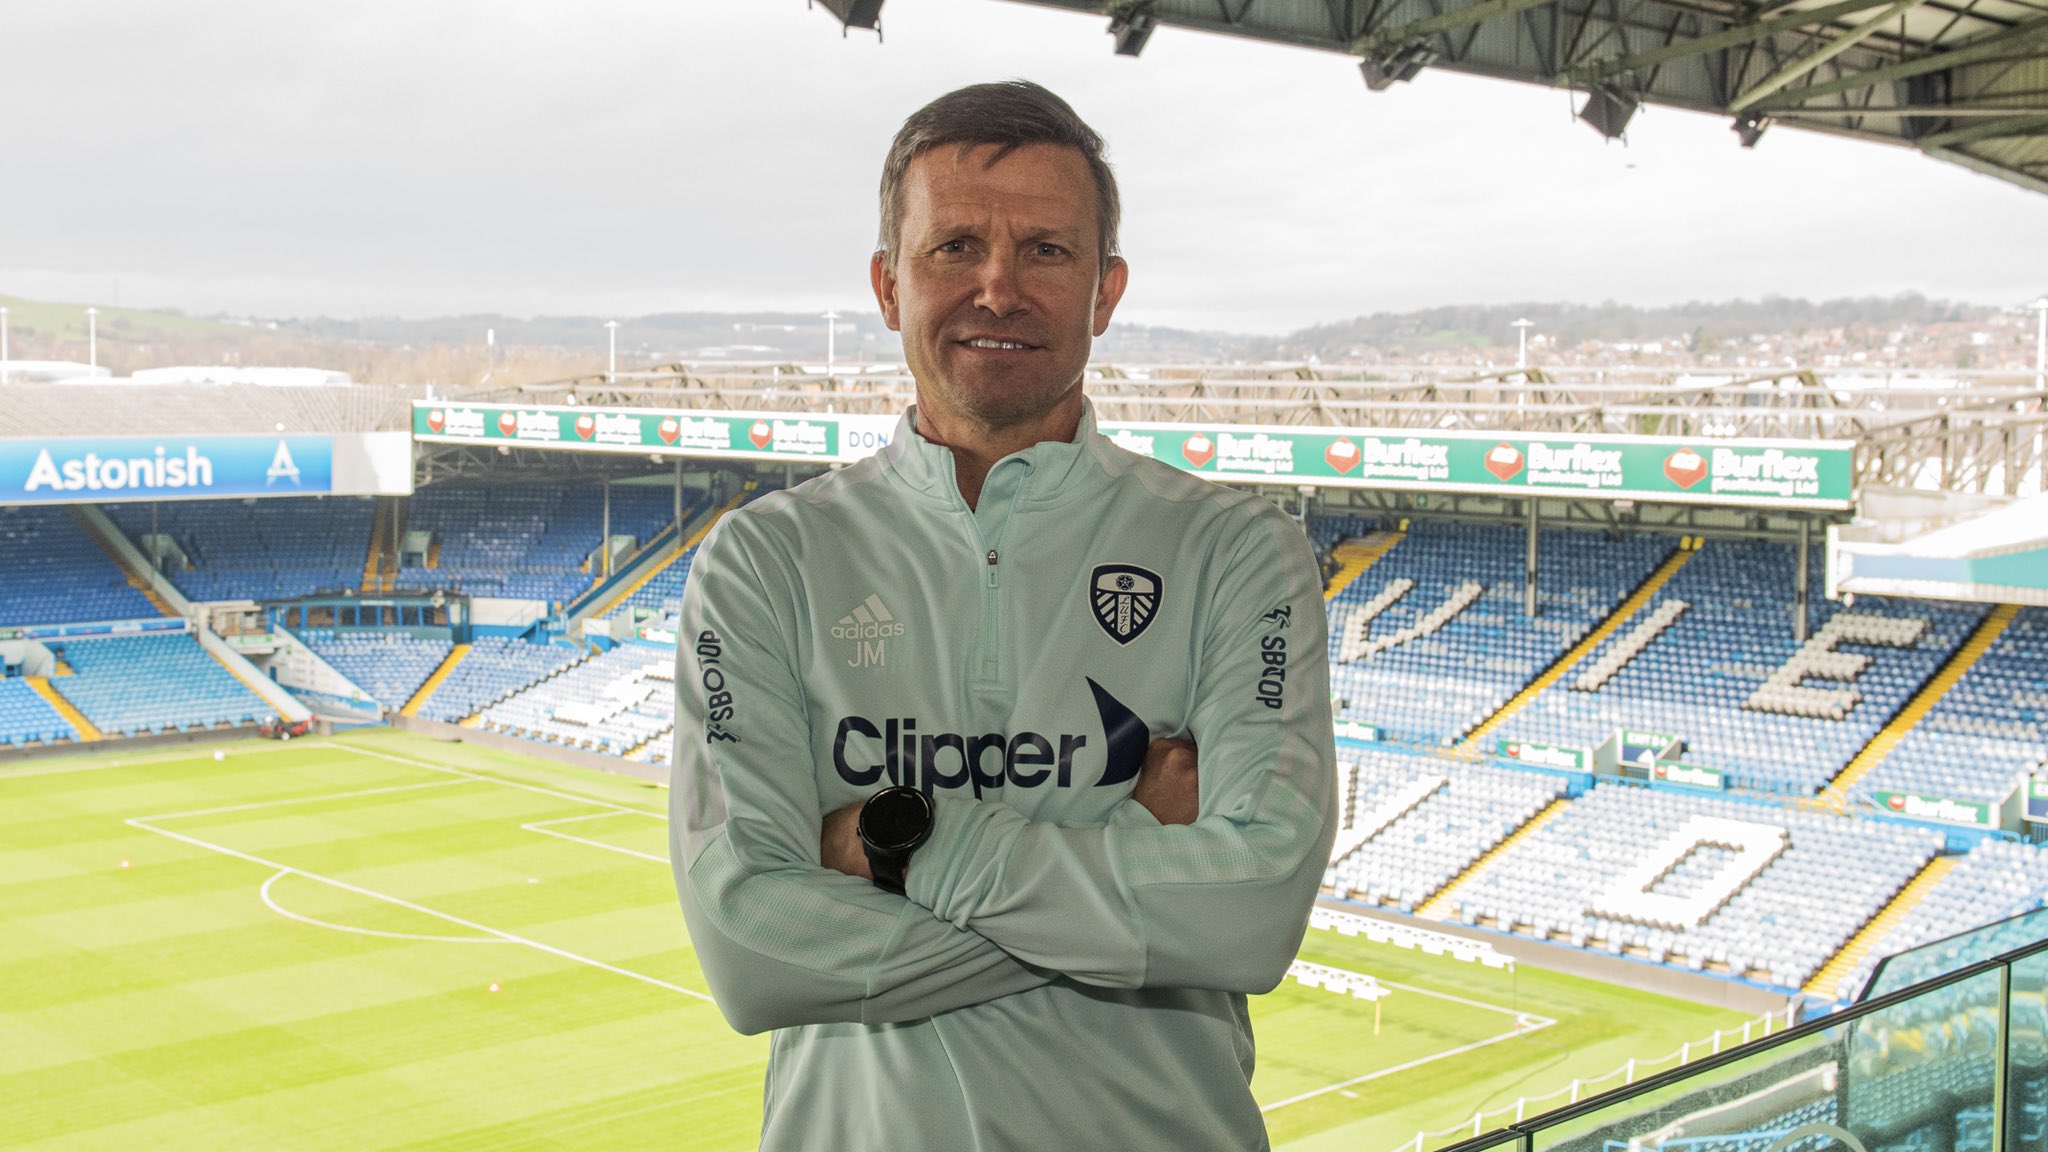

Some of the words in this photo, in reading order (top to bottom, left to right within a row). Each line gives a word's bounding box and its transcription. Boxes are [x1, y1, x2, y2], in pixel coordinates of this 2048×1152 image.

[1110, 430, 1154, 455] flex
[1217, 433, 1293, 459] Burflex
[1364, 438, 1448, 466] Burflex
[24, 446, 213, 491] Astonish
[1529, 443, 1621, 472] Burflex
[1713, 449, 1817, 479] Burflex
[830, 621, 905, 640] adidas
[847, 640, 885, 668] JM
[697, 630, 734, 721] SBOTOP
[833, 716, 1086, 801] Clipper
